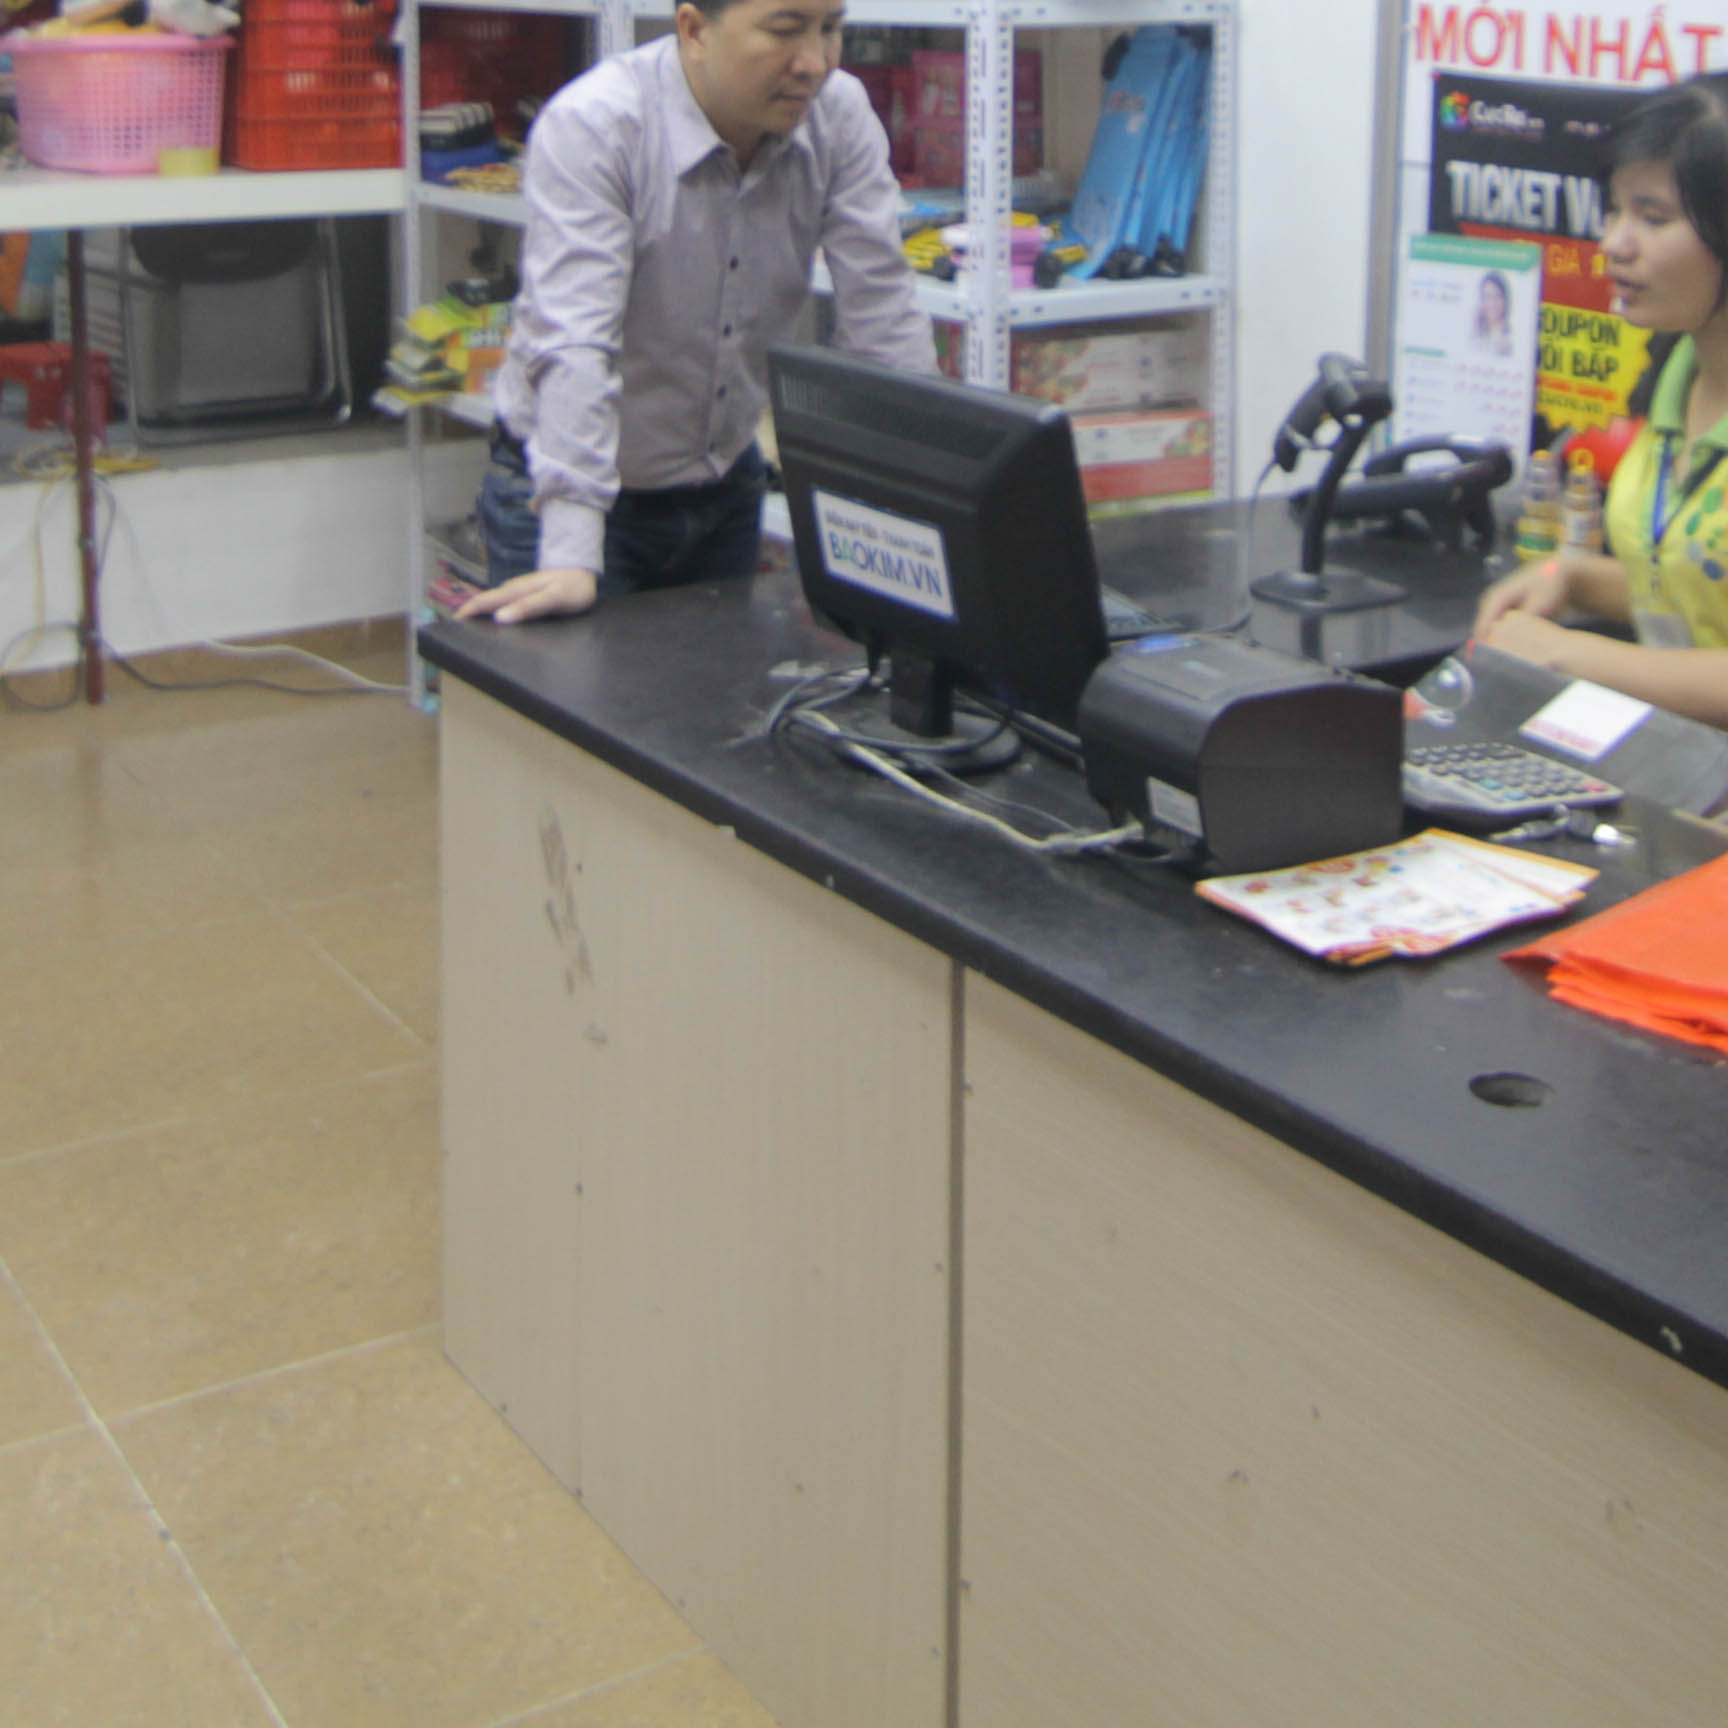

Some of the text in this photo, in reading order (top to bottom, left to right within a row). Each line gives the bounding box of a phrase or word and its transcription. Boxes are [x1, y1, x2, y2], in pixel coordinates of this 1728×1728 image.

[1543, 3, 1724, 84] NHẤT
[1445, 159, 1562, 232] TICKET
[828, 530, 943, 598] BAOKIM.VN
